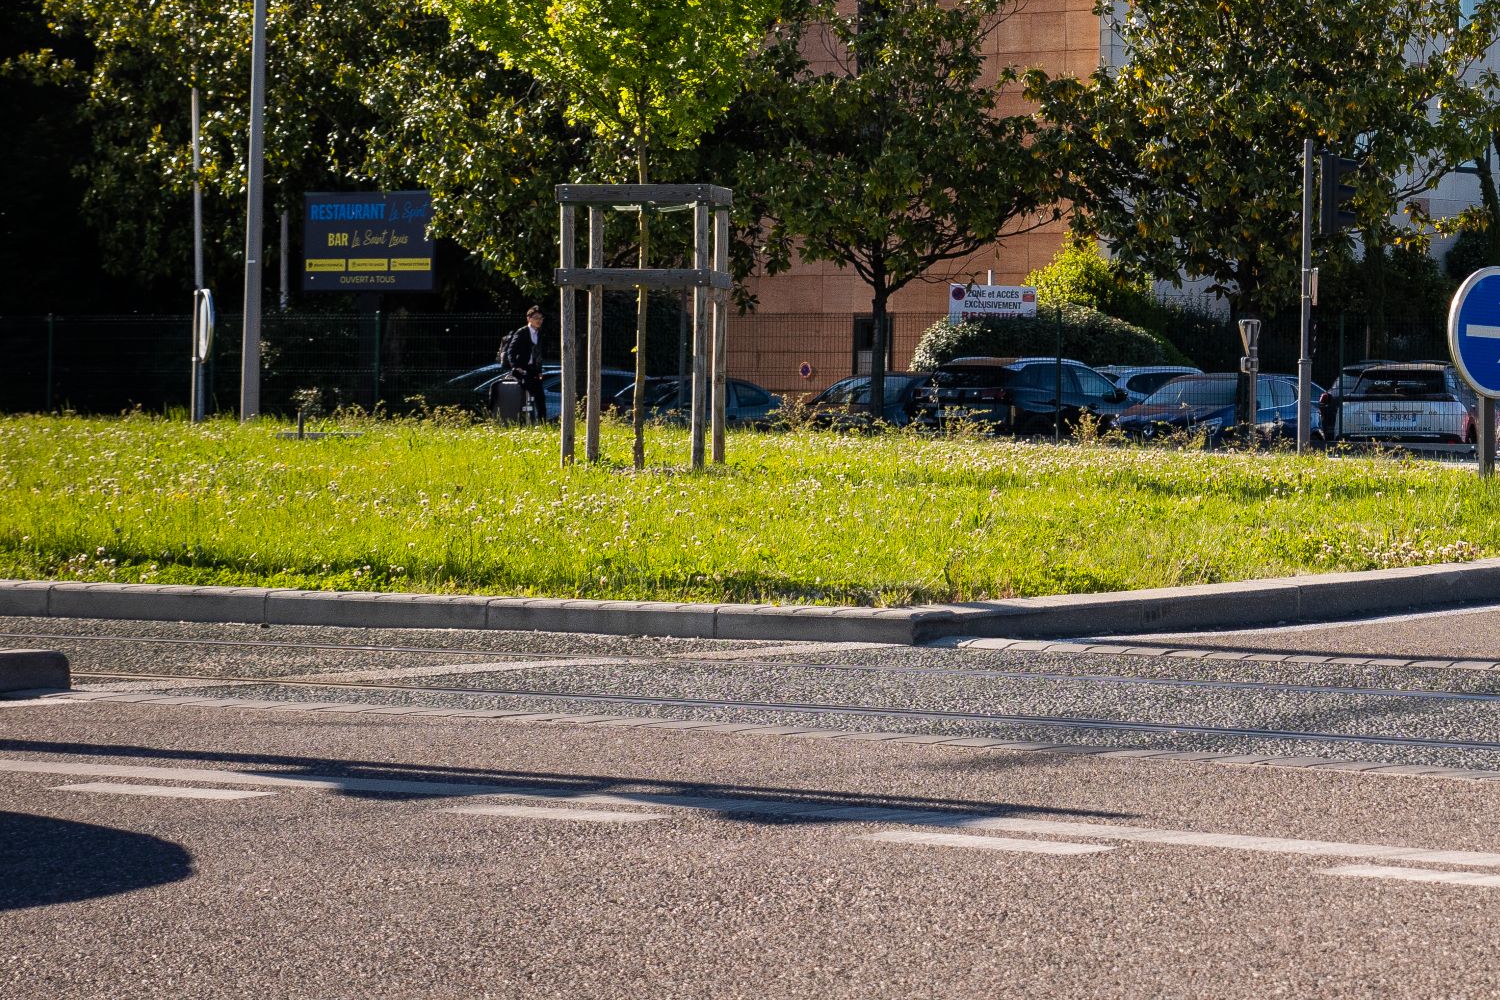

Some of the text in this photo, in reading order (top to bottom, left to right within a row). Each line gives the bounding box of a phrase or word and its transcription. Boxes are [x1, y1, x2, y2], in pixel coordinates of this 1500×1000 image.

[311, 203, 386, 220] RESTAURANT
[328, 233, 349, 246] BAR
[363, 229, 388, 245] Saint
[388, 229, 408, 247] Louis
[340, 276, 369, 284] OUVERT
[967, 289, 1020, 298] ZONE et ACCÈS
[965, 300, 1022, 310] EXCLUSIVEMENT
